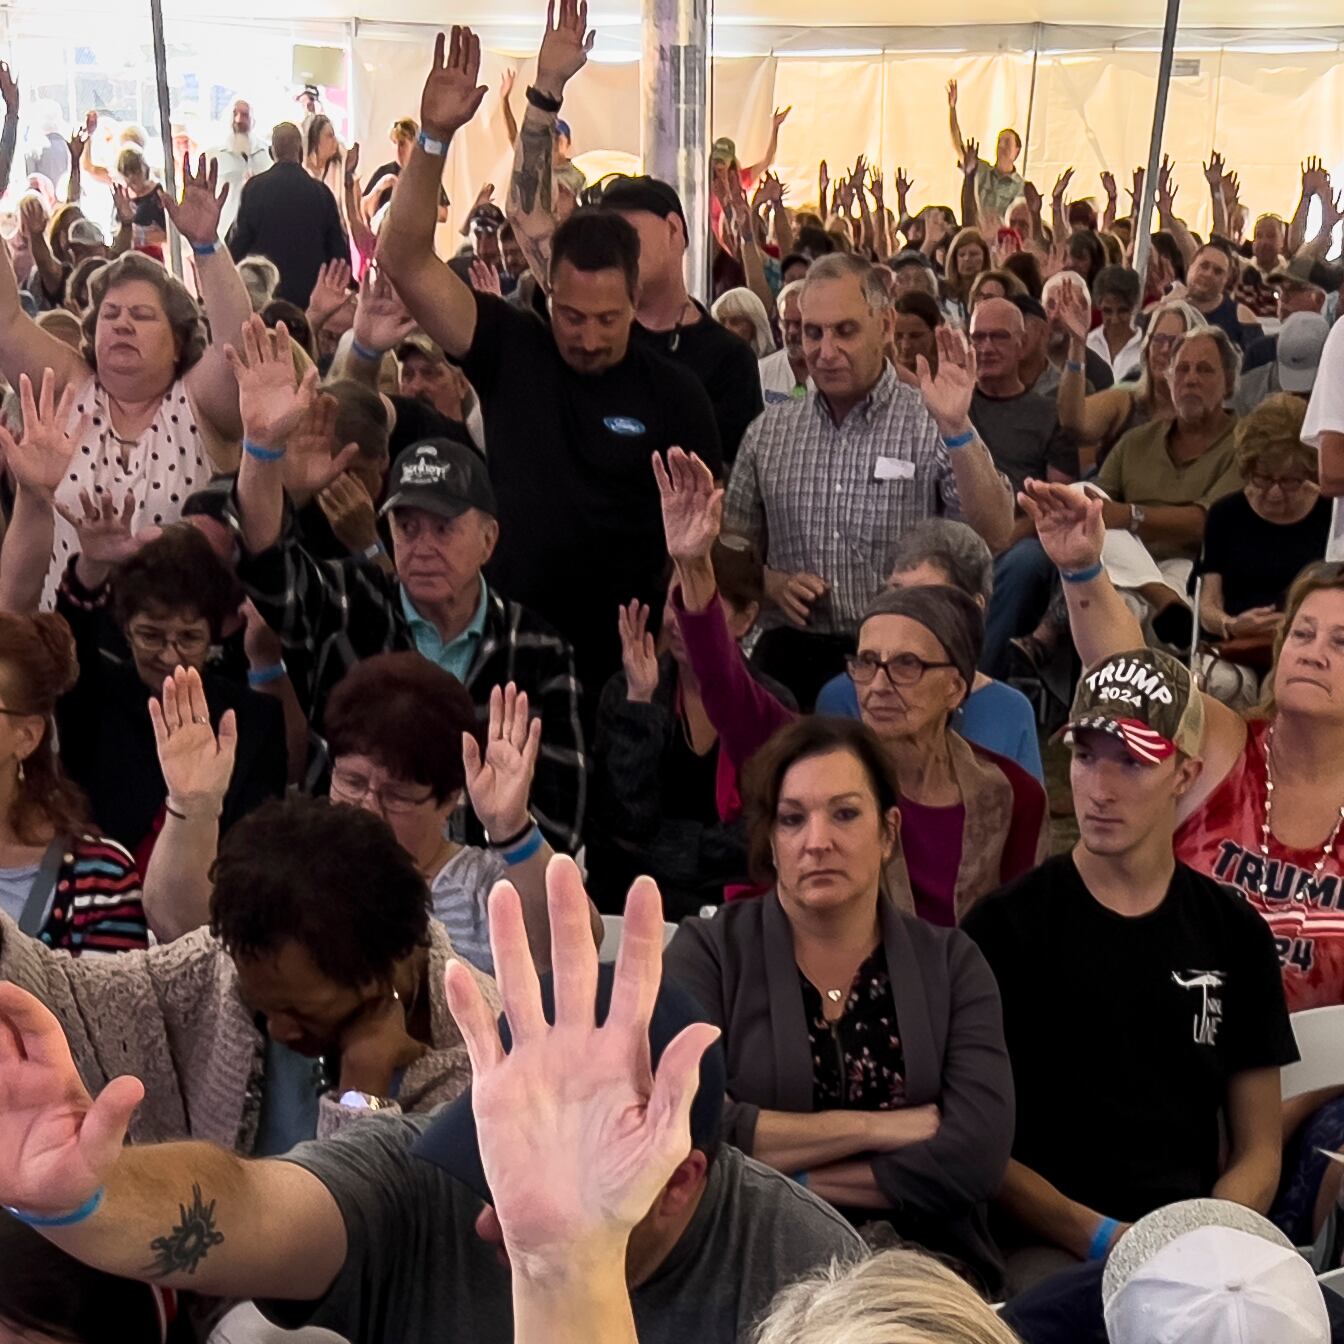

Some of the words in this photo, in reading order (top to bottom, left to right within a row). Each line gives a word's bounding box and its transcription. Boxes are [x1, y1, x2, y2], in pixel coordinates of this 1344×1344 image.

[1085, 661, 1173, 704] TRUMP
[1099, 686, 1142, 707] 2024
[1273, 936, 1314, 972] 24
